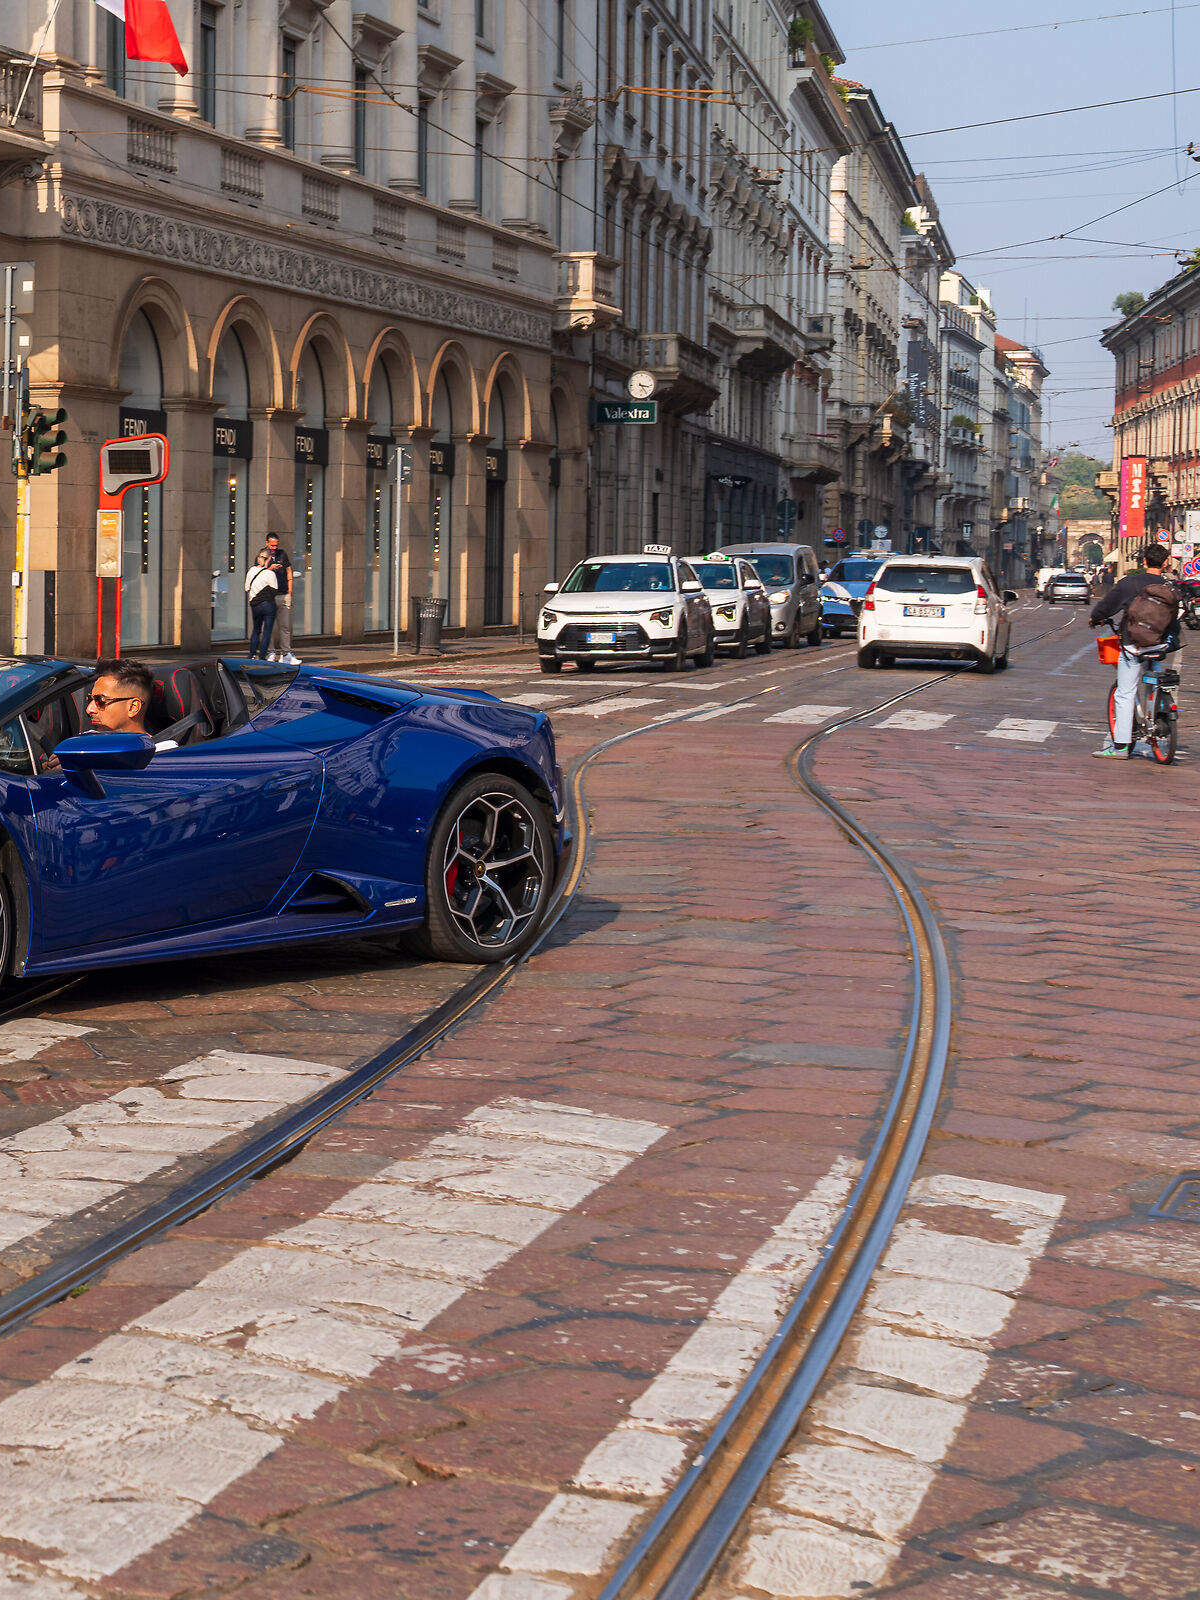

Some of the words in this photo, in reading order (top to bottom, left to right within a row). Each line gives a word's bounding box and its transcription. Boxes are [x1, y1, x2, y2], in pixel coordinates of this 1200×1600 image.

[604, 407, 650, 420] Valextra
[124, 417, 148, 436] FENDI
[216, 427, 237, 446] FENDI
[296, 436, 315, 453] FENDI
[647, 545, 669, 553] TAXI
